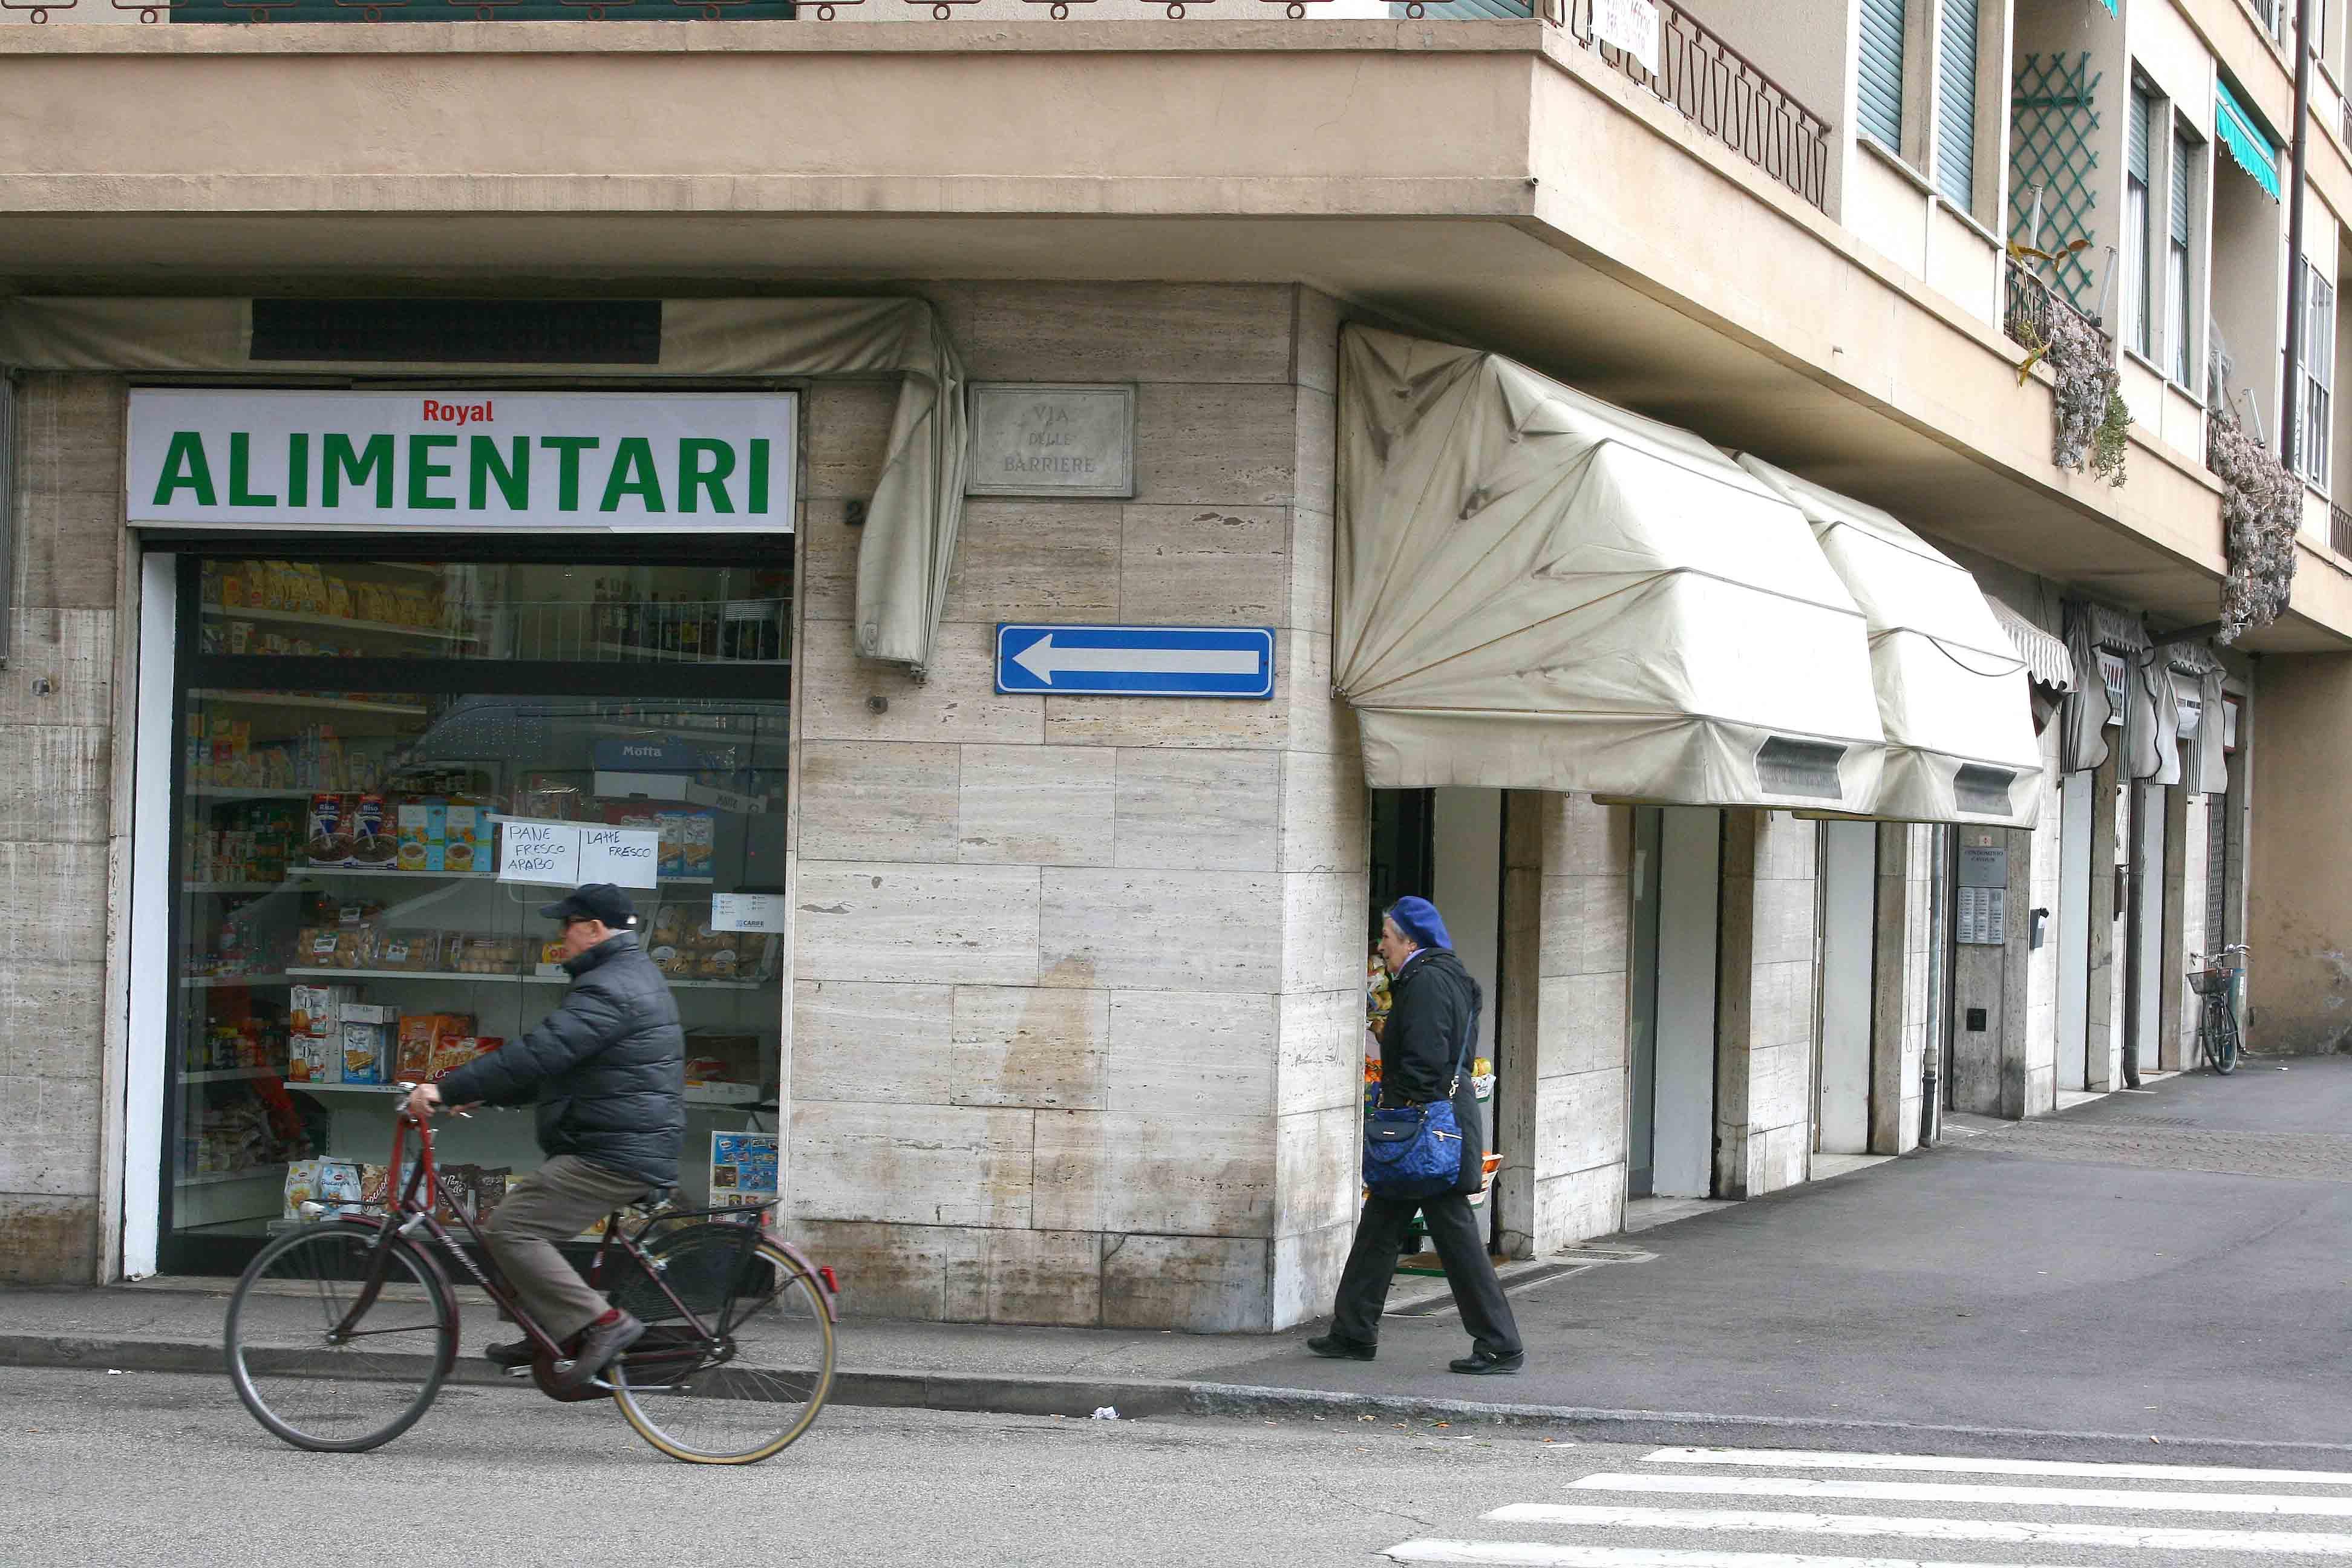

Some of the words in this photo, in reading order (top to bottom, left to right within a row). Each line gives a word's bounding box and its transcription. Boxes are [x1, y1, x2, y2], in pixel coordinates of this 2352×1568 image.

[423, 400, 493, 426] Royal
[1033, 406, 1069, 422] VIA
[1029, 432, 1071, 446] DELLE
[1004, 455, 1096, 473] BARRIERE
[153, 431, 769, 514] ALIMENTARI
[622, 745, 663, 757] Motta
[509, 826, 552, 841] PANE
[515, 844, 566, 857] FRESCO
[609, 846, 651, 858] FRESCO
[508, 857, 555, 871] ARABO
